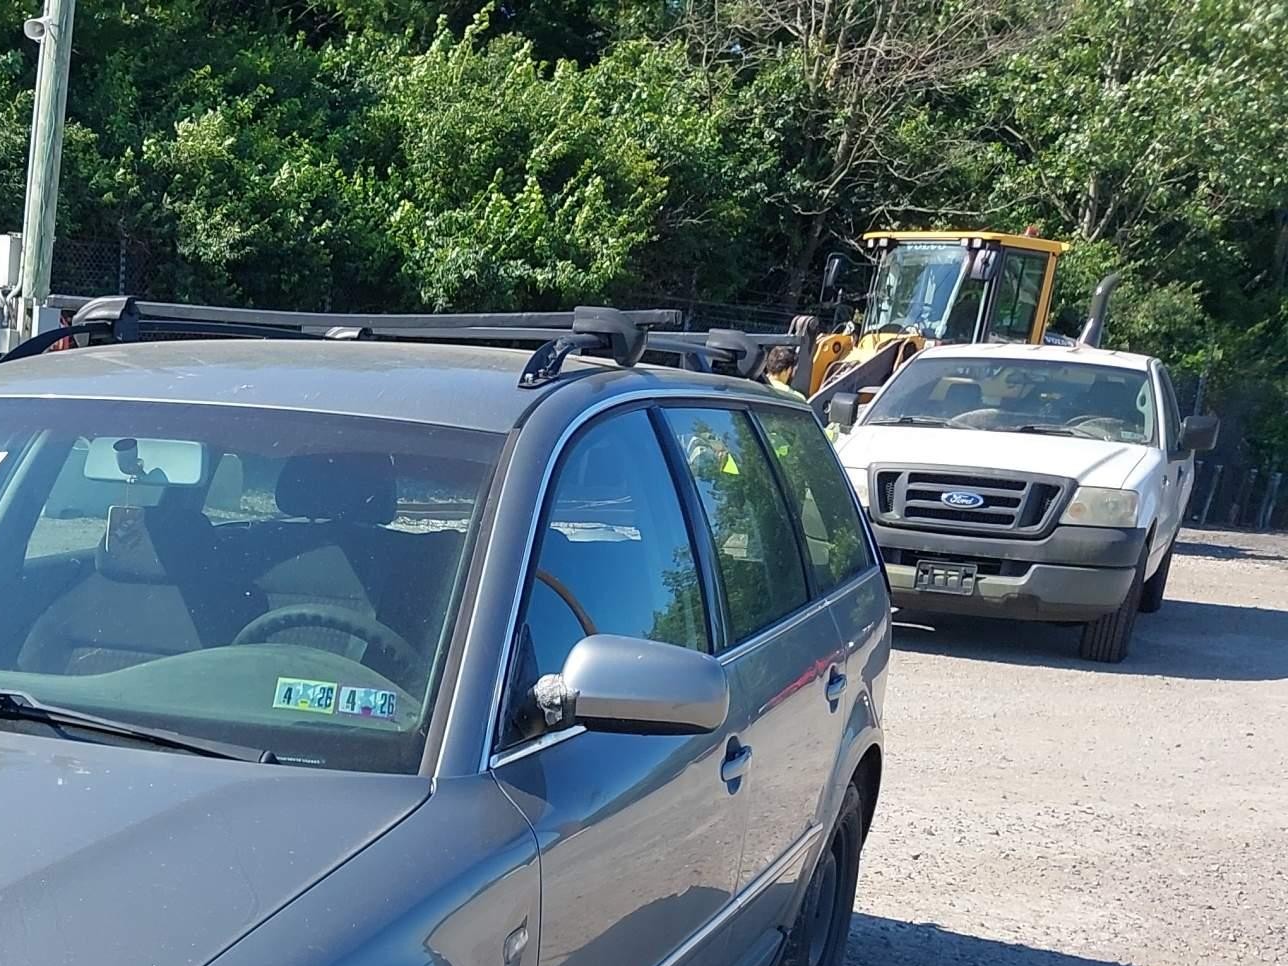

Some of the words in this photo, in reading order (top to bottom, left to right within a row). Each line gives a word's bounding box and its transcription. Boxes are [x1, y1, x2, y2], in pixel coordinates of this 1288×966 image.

[947, 492, 978, 506] Ford
[283, 687, 292, 705] 4
[318, 687, 333, 708] 26
[346, 690, 356, 711] 4
[380, 693, 394, 715] 26
